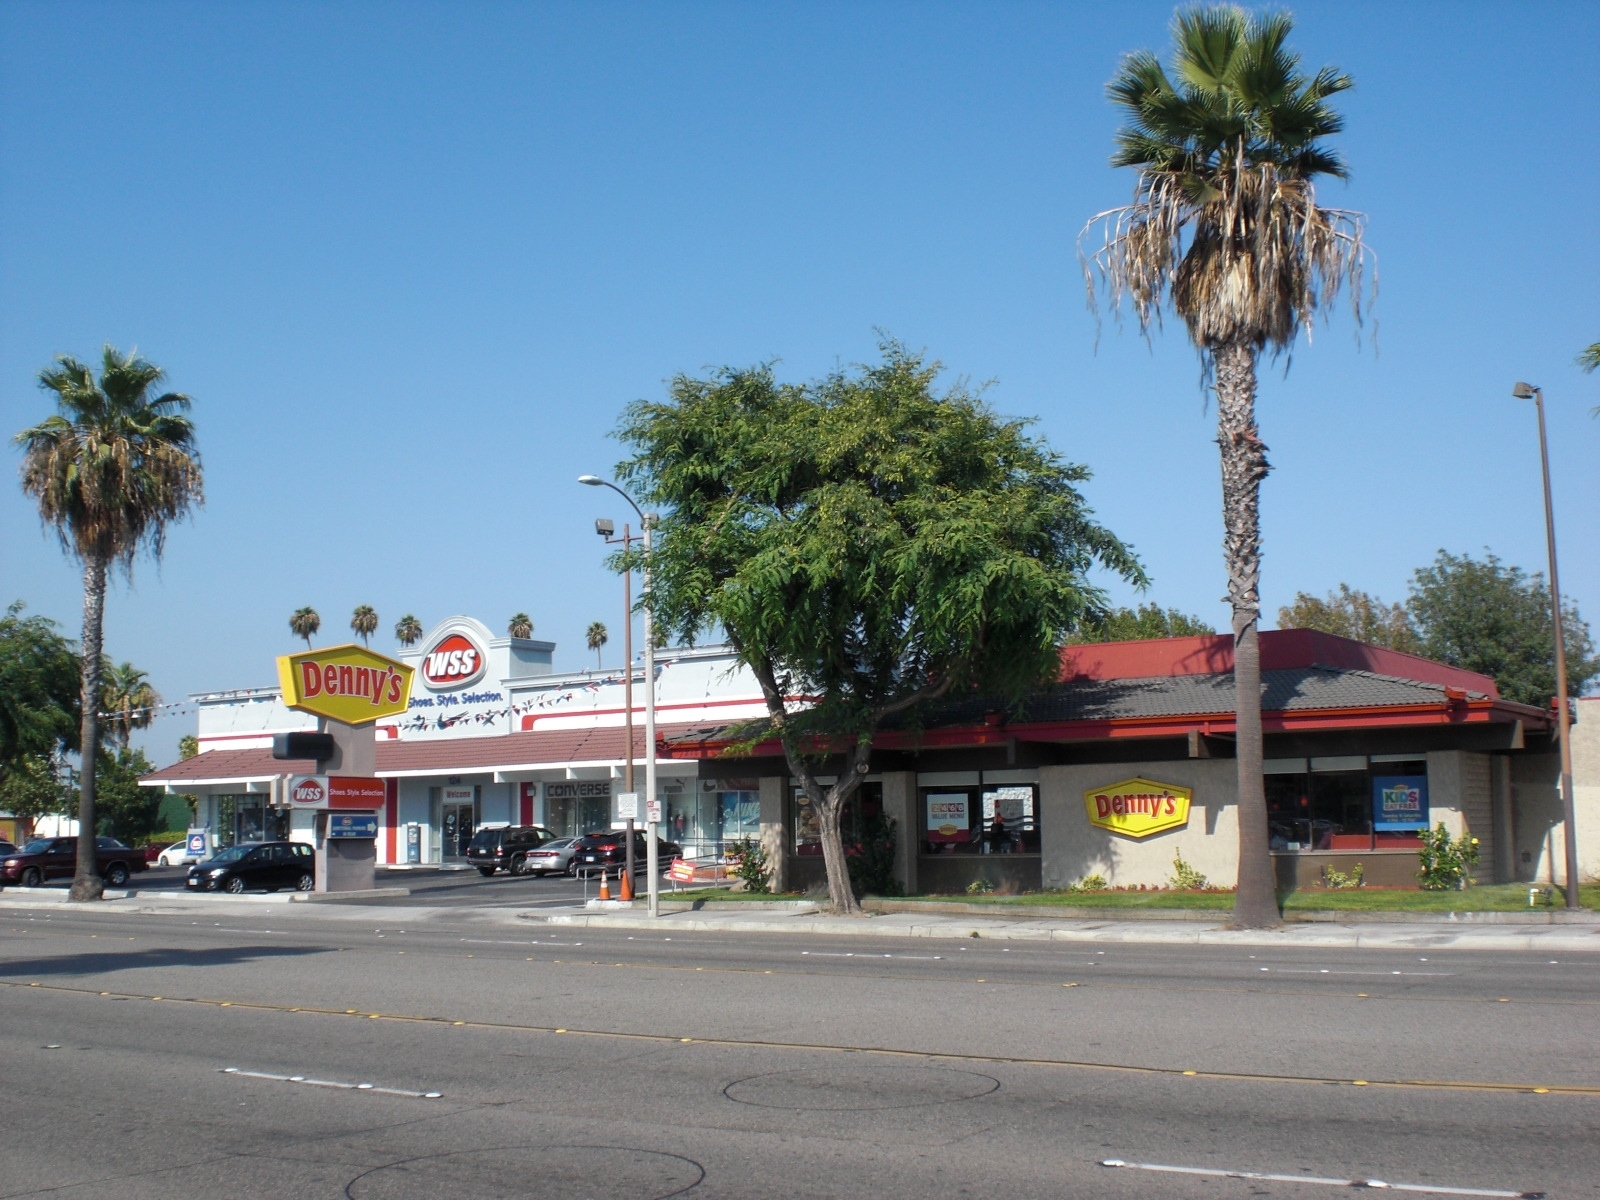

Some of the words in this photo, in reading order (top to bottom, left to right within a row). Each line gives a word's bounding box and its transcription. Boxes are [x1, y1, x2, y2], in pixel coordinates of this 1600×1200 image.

[427, 648, 477, 677] WSS
[301, 660, 403, 706] Denny's
[437, 694, 460, 708] Style.
[461, 691, 504, 704] Selection.
[296, 787, 322, 800] WSS
[446, 790, 471, 798] Welcome
[547, 783, 611, 797] CONVERSE
[1384, 792, 1417, 803] KIDS
[1094, 790, 1176, 819] Denny's
